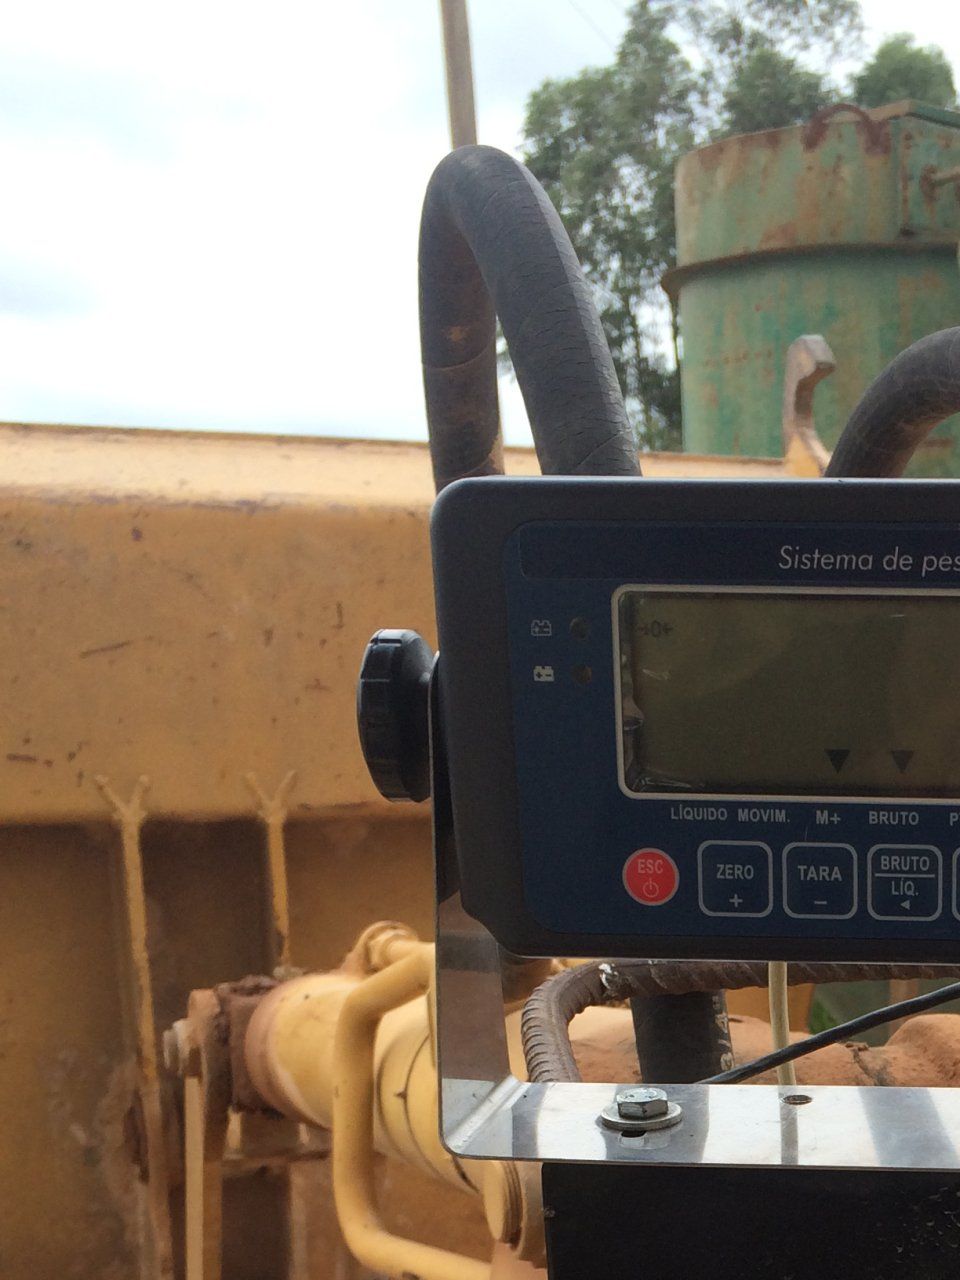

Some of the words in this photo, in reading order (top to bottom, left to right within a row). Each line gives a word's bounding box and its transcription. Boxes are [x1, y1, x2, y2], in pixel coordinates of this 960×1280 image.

[779, 545, 873, 571] Sistema
[883, 546, 913, 572] de
[671, 804, 728, 821] LÍQUIDO
[738, 808, 791, 823] MOVIM.
[816, 810, 841, 825] M+
[869, 811, 919, 826] BRUTO
[637, 859, 663, 874] ESC
[880, 856, 930, 871] BRUTO
[716, 864, 754, 880] ZERO
[798, 865, 843, 881] TARA
[891, 877, 919, 896] LÍQ.
